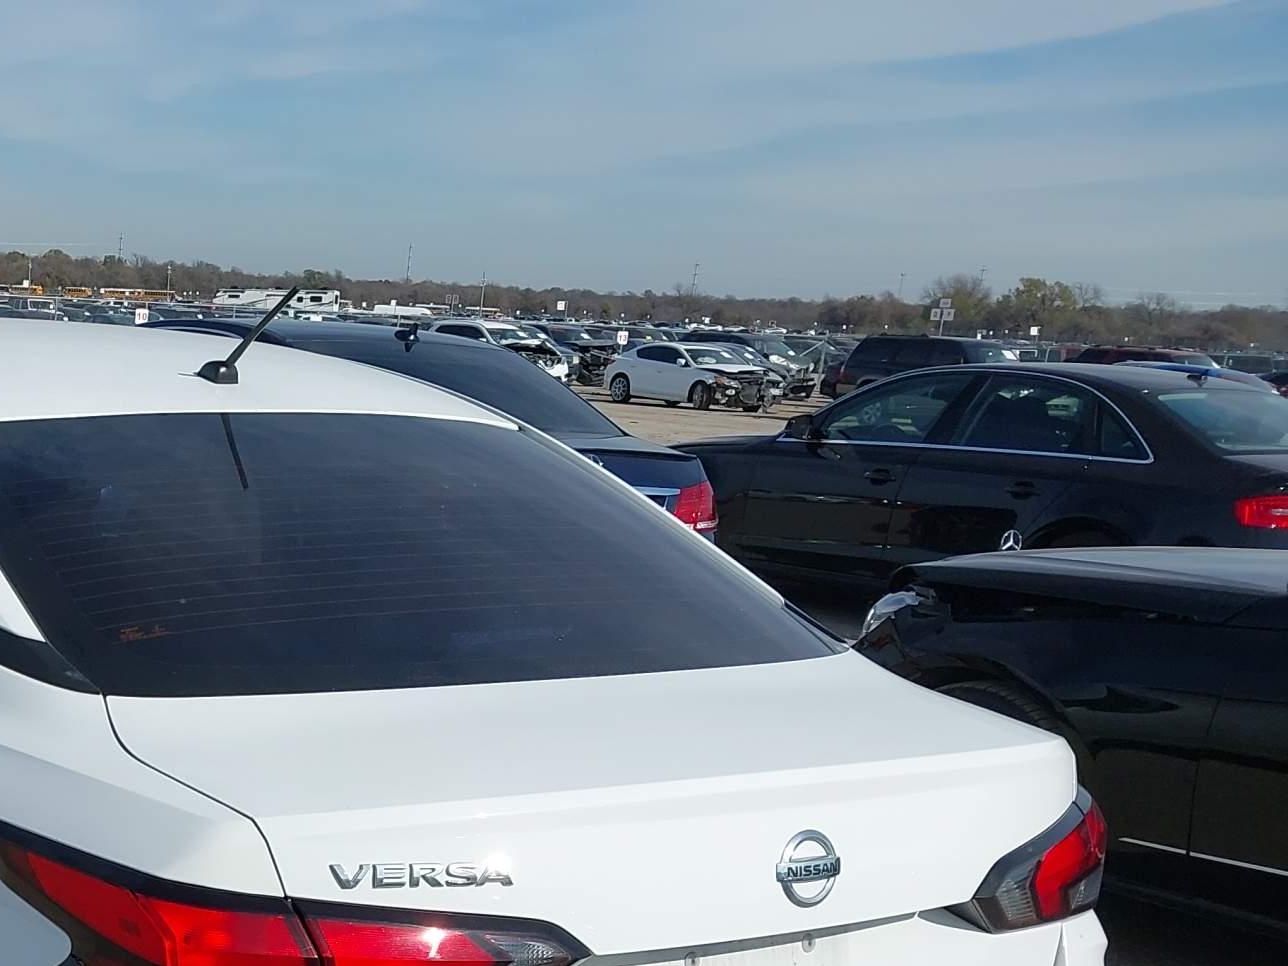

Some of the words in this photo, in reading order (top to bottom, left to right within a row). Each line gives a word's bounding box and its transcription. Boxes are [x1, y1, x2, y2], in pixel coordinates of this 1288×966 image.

[137, 312, 147, 321] 10
[328, 862, 514, 890] VERSA
[786, 857, 841, 878] NISSAN
